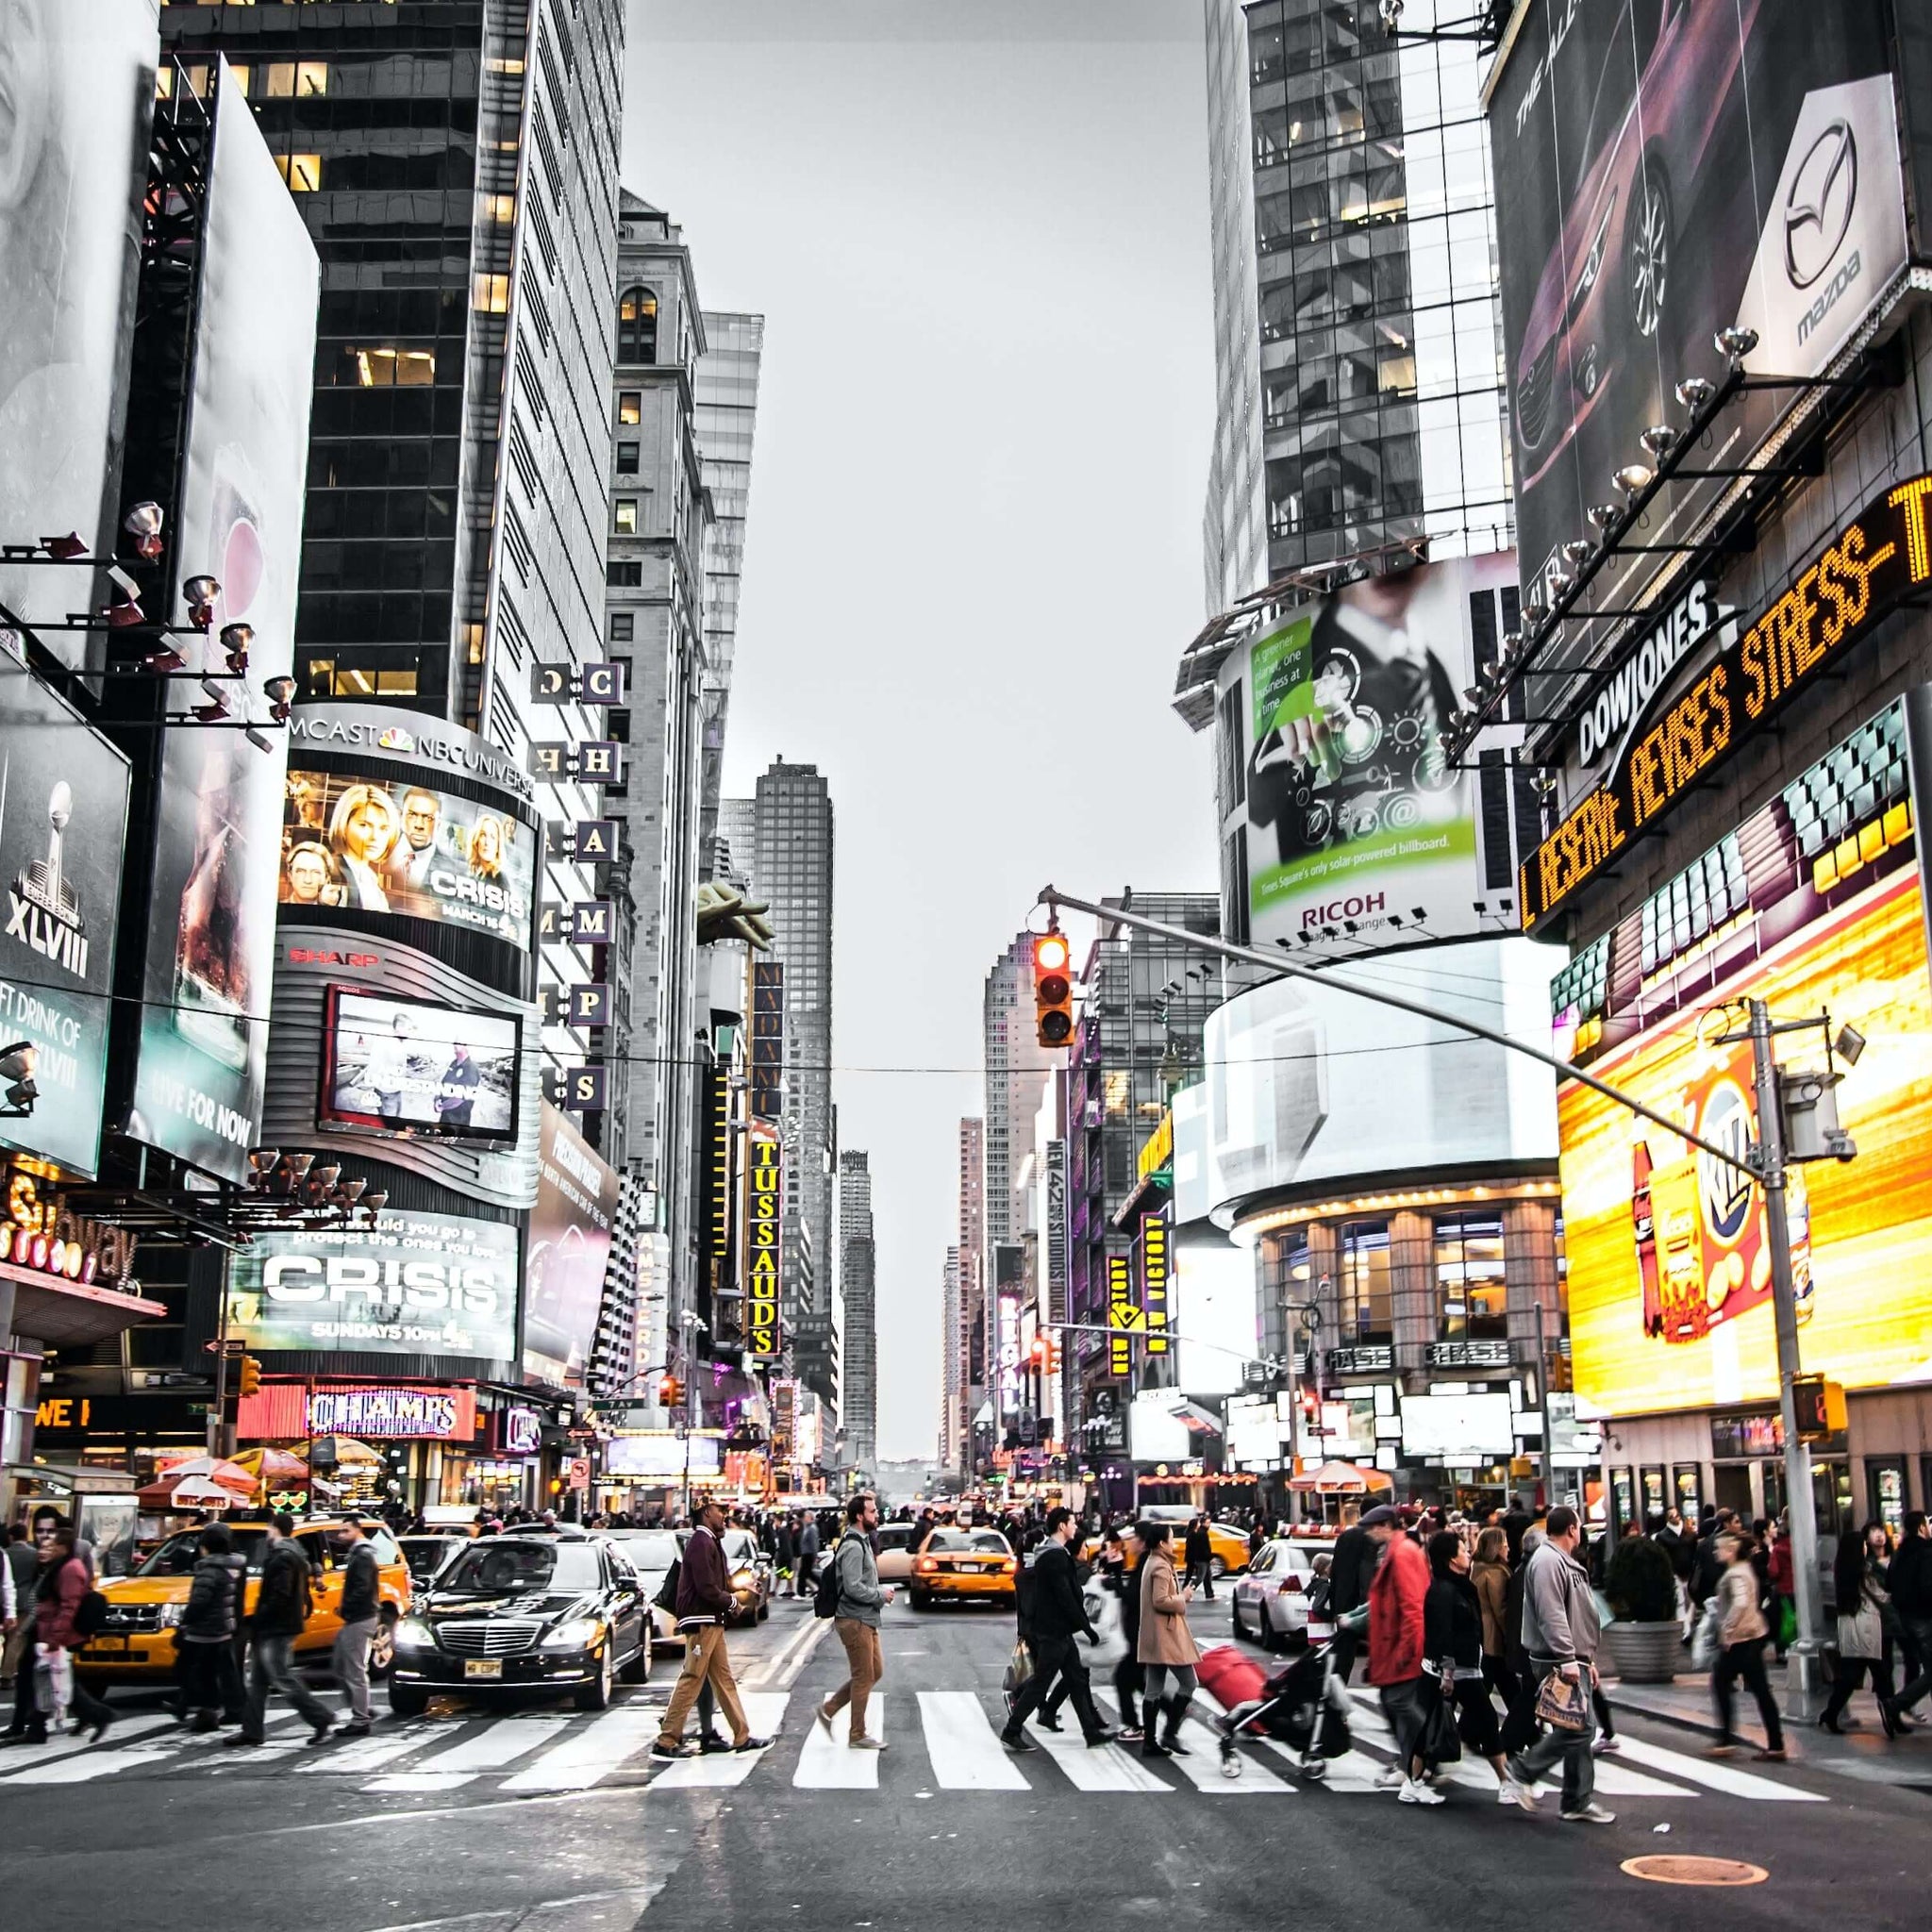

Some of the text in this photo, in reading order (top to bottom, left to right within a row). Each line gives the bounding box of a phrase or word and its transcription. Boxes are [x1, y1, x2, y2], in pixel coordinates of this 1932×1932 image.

[1516, 57, 1541, 139] THE
[1283, 650, 1301, 666] one
[1291, 668, 1300, 680] at
[1630, 664, 1730, 826] REVISES
[1261, 834, 1450, 896] Times Square's only solar-powered billboard.
[430, 870, 525, 919] CRISIS
[1302, 891, 1385, 929] RICOH
[5, 890, 89, 980] XLVIII
[290, 947, 379, 967] SHARP
[17, 991, 60, 1041] DRINK
[62, 1017, 82, 1049] OF
[187, 1088, 216, 1131] FOR
[216, 1104, 252, 1148] NOW
[1047, 1141, 1063, 1170] NEW
[293, 1229, 363, 1246] protect
[367, 1231, 398, 1247] the
[402, 1236, 441, 1252] ones
[446, 1242, 470, 1256] you
[408, 1224, 437, 1239] you
[441, 1229, 459, 1240] go
[753, 1141, 779, 1354] TUSSAUD'S
[1145, 1218, 1165, 1300] VICTORY
[263, 1255, 498, 1313] CRISIS
[310, 1322, 402, 1341] SUNDAYS
[310, 1393, 458, 1432] CHAMPS
[608, 1401, 616, 1410] 7
